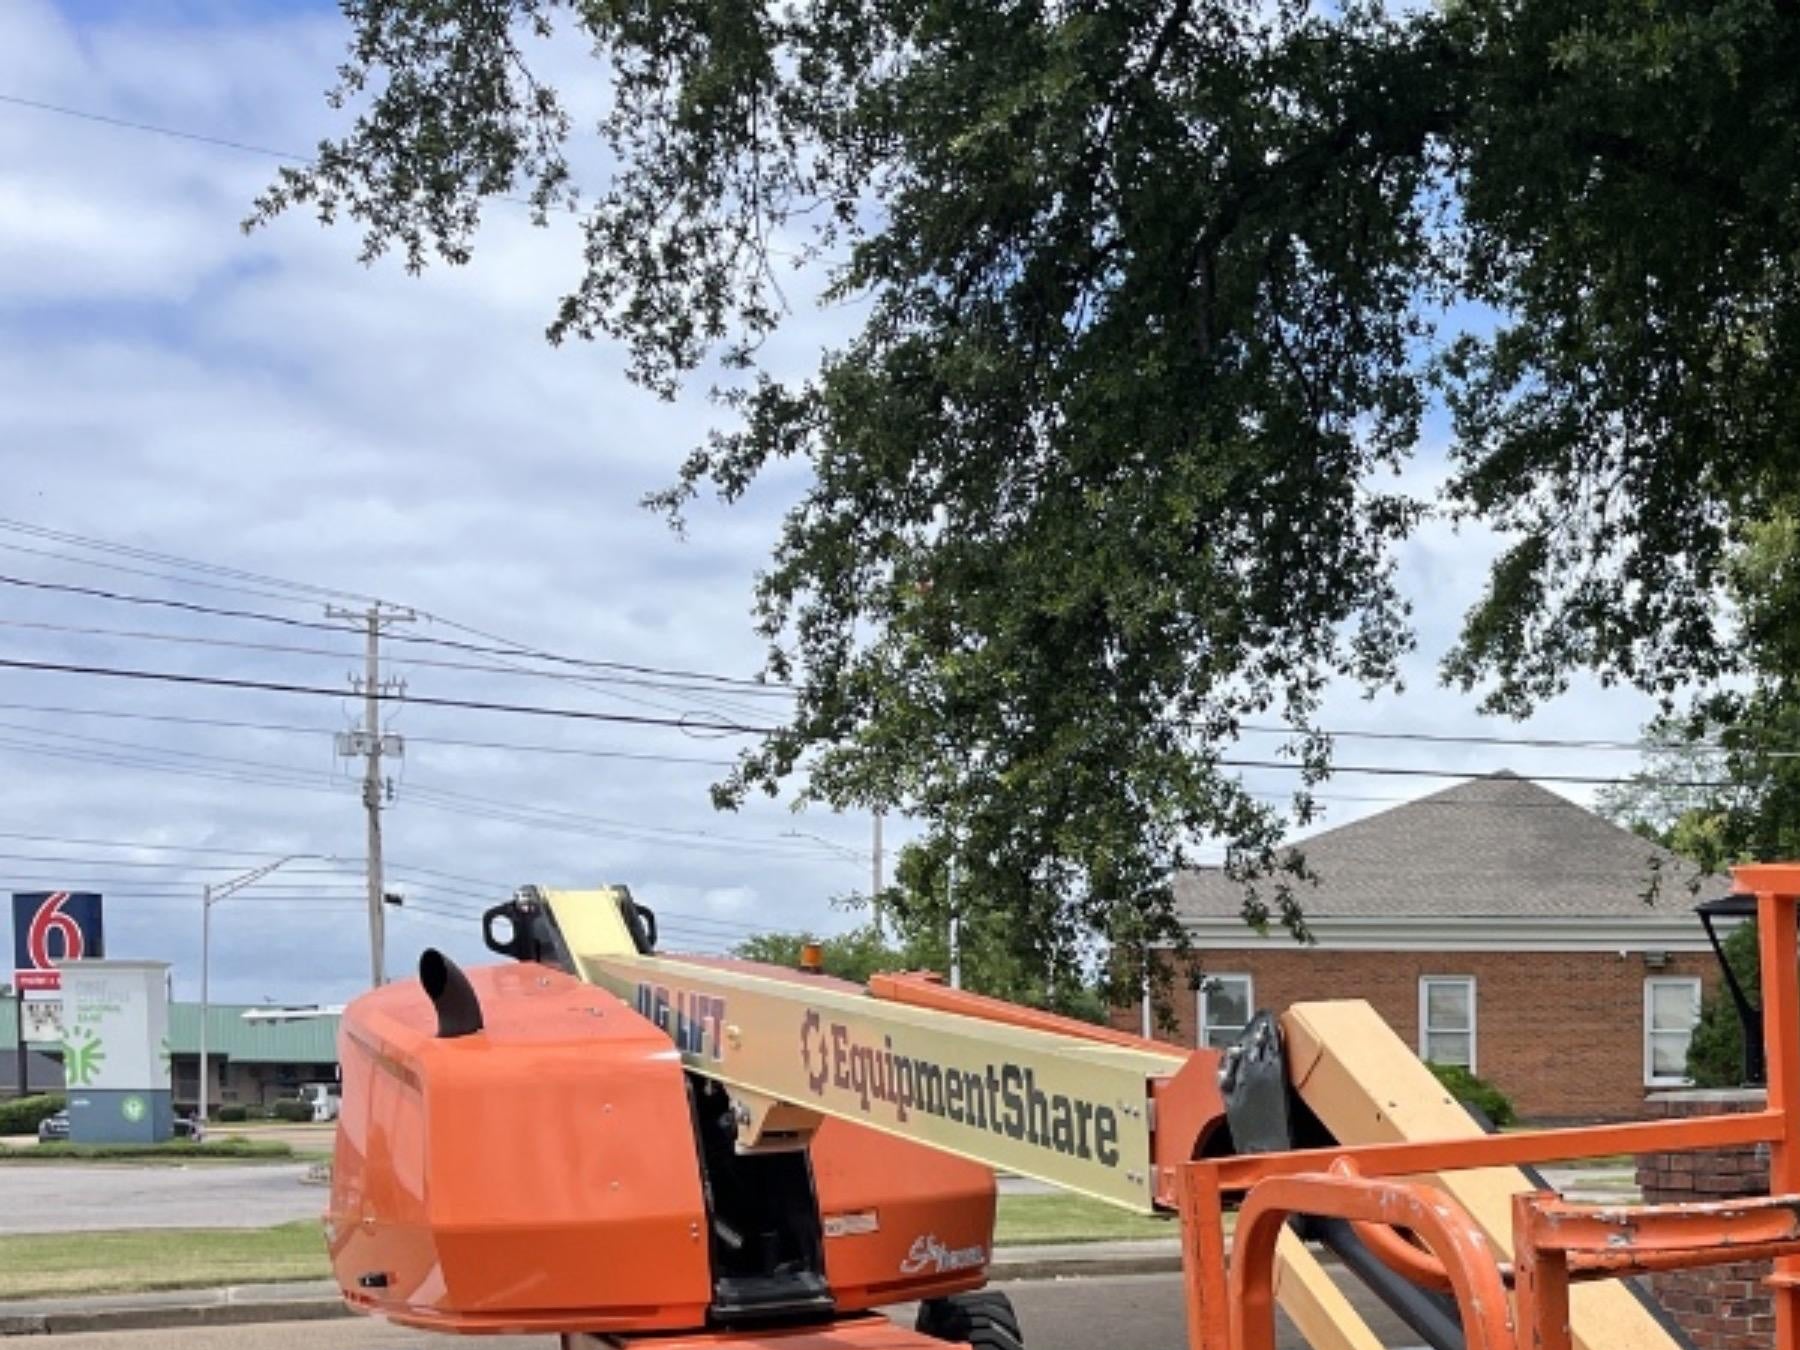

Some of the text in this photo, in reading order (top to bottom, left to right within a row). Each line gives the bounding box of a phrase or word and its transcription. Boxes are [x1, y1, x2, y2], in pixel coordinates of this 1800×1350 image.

[30, 892, 82, 969] 6
[677, 989, 725, 1060] LIFT
[831, 1022, 1119, 1168] EquipmentShare
